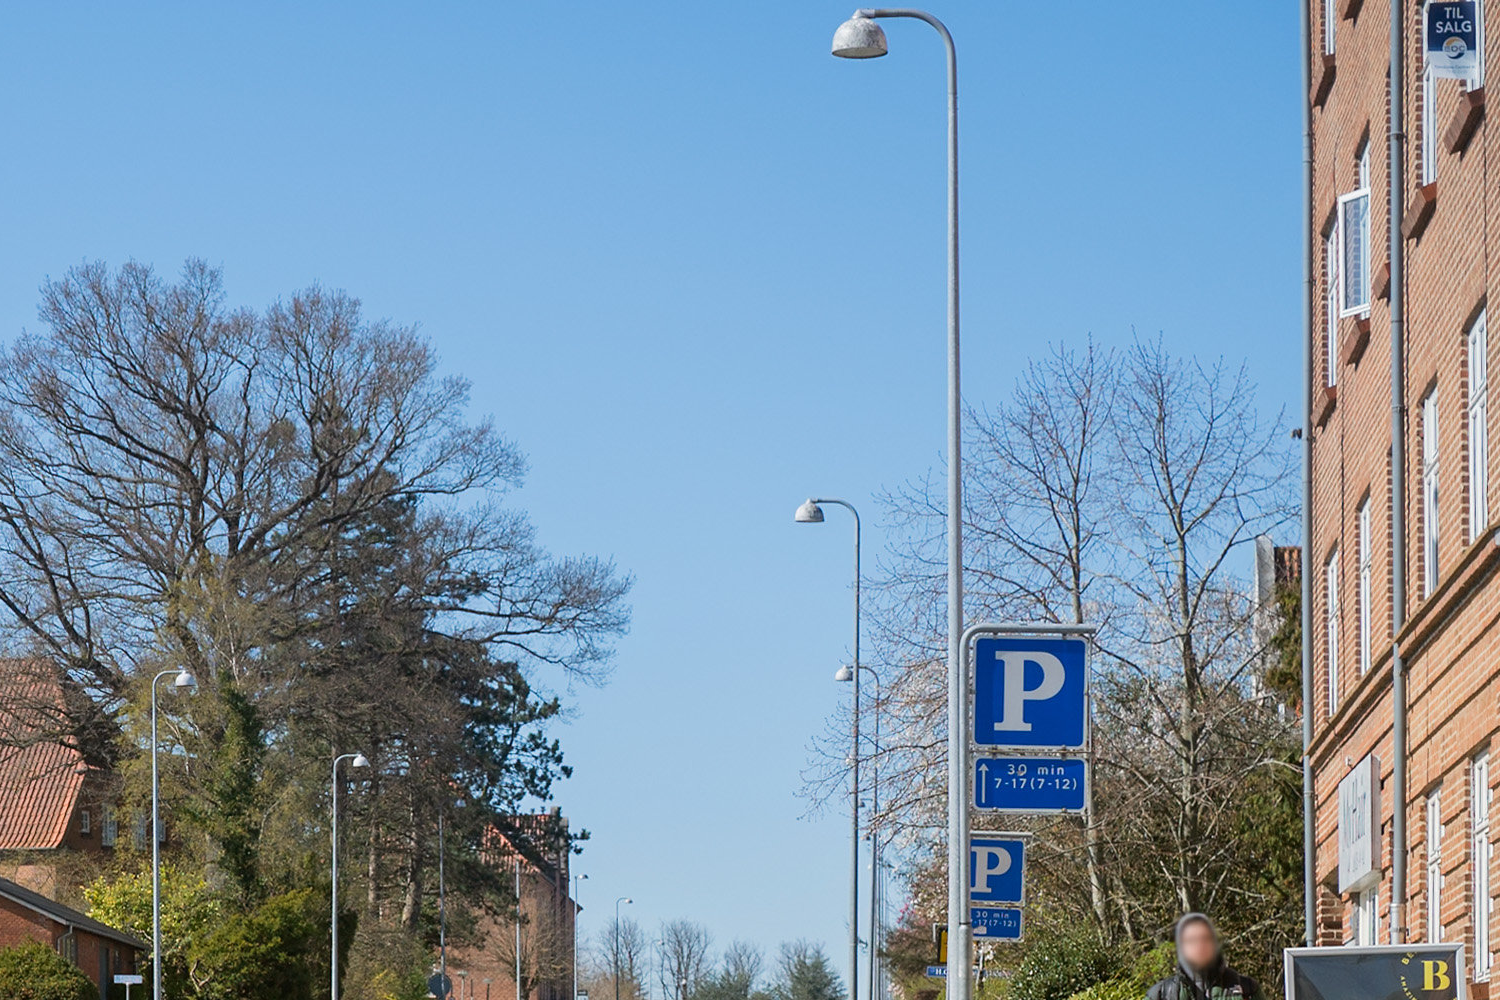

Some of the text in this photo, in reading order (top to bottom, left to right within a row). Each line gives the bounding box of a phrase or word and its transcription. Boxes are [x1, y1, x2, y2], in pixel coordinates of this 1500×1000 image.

[1444, 7, 1464, 19] TIL
[1435, 20, 1472, 33] SALG
[994, 651, 1066, 731] P
[1007, 764, 1065, 776] 30 min
[994, 778, 1078, 791] 7-17(7-12)
[971, 846, 1012, 893] P
[971, 919, 1017, 927] -17(7-12)
[1421, 960, 1451, 991] B
